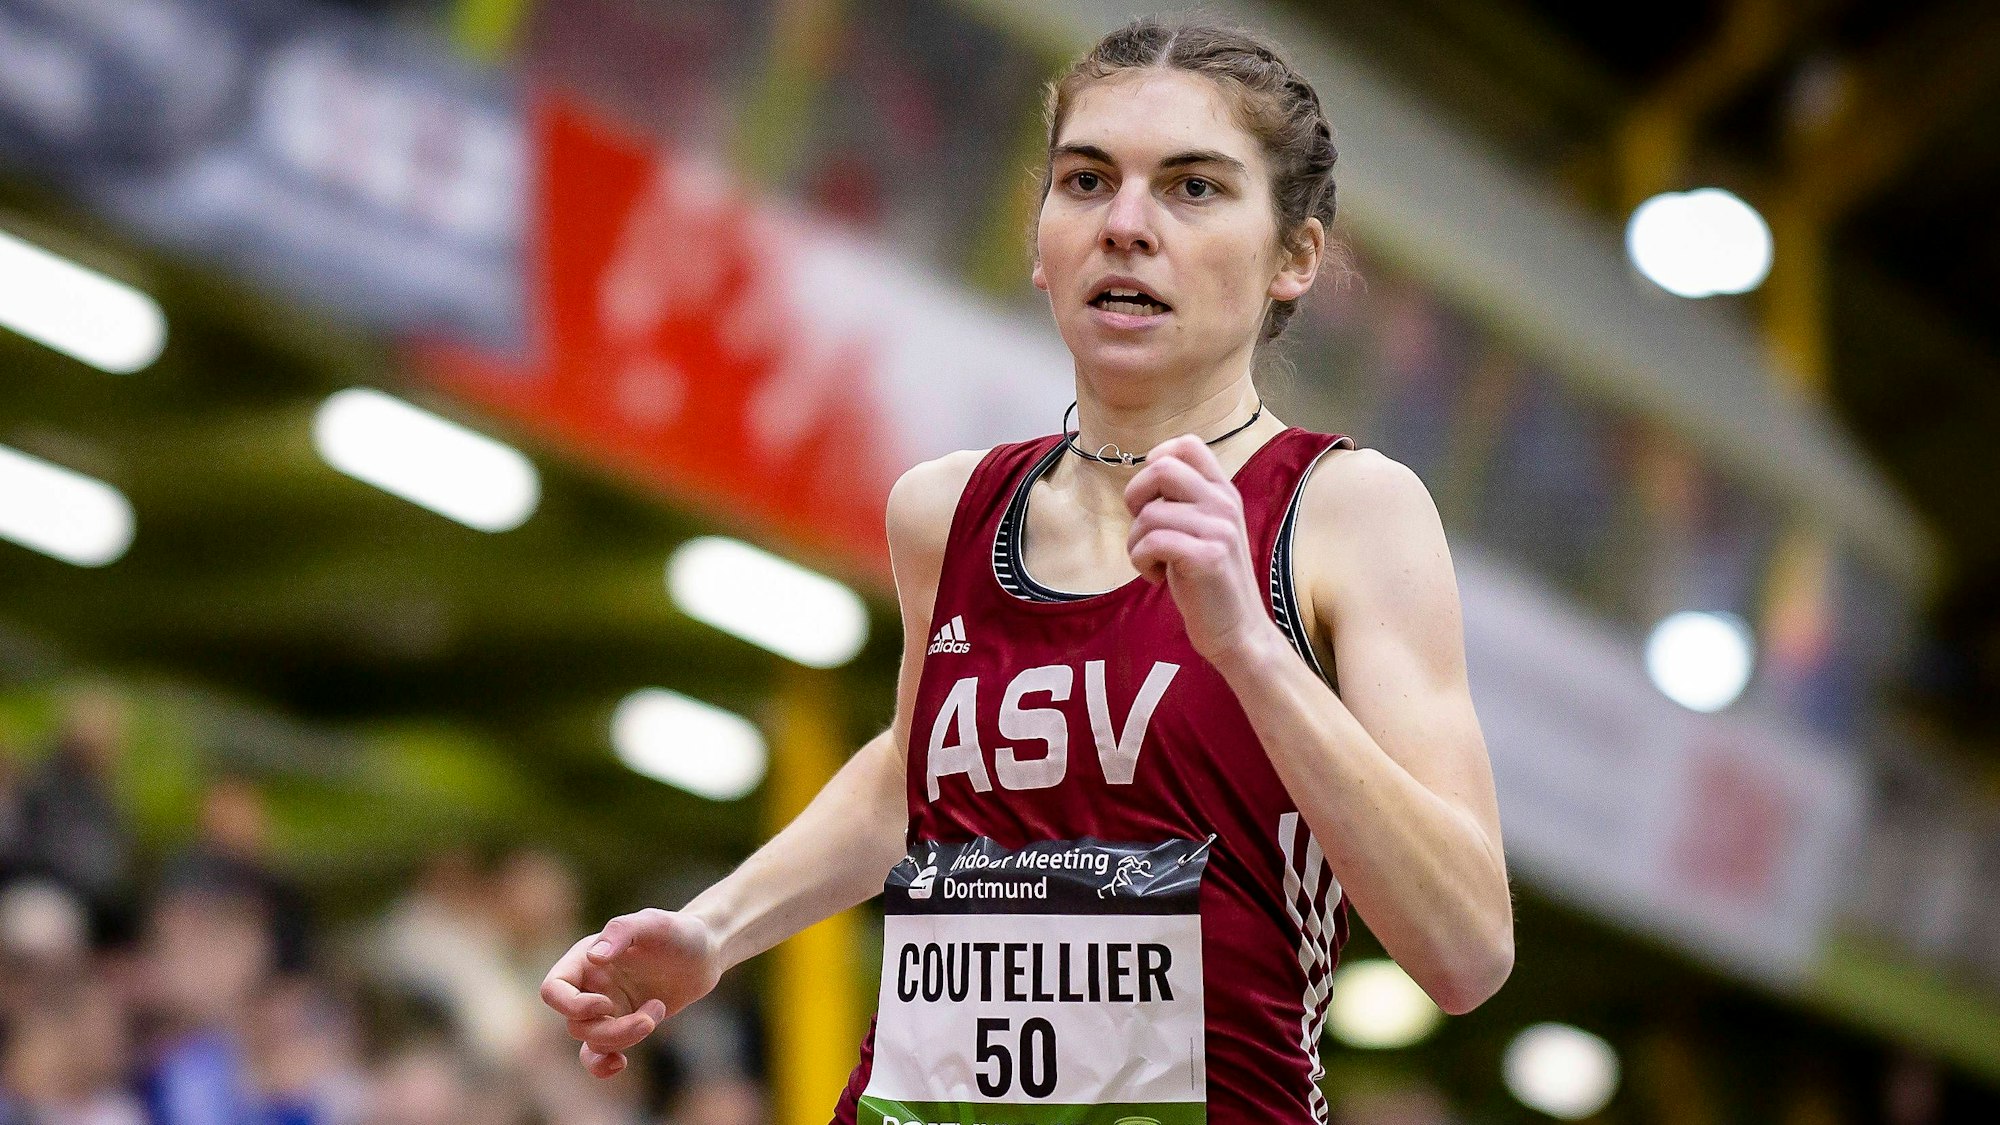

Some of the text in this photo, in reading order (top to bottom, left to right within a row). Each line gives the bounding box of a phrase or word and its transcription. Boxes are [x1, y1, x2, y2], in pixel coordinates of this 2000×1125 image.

[928, 638, 971, 655] adidas
[926, 660, 1181, 803] ASV
[1016, 849, 1109, 875] Meeting
[943, 876, 1047, 899] Dortmund
[897, 942, 1174, 1003] COUTELLIER
[975, 1017, 1058, 1099] 50
